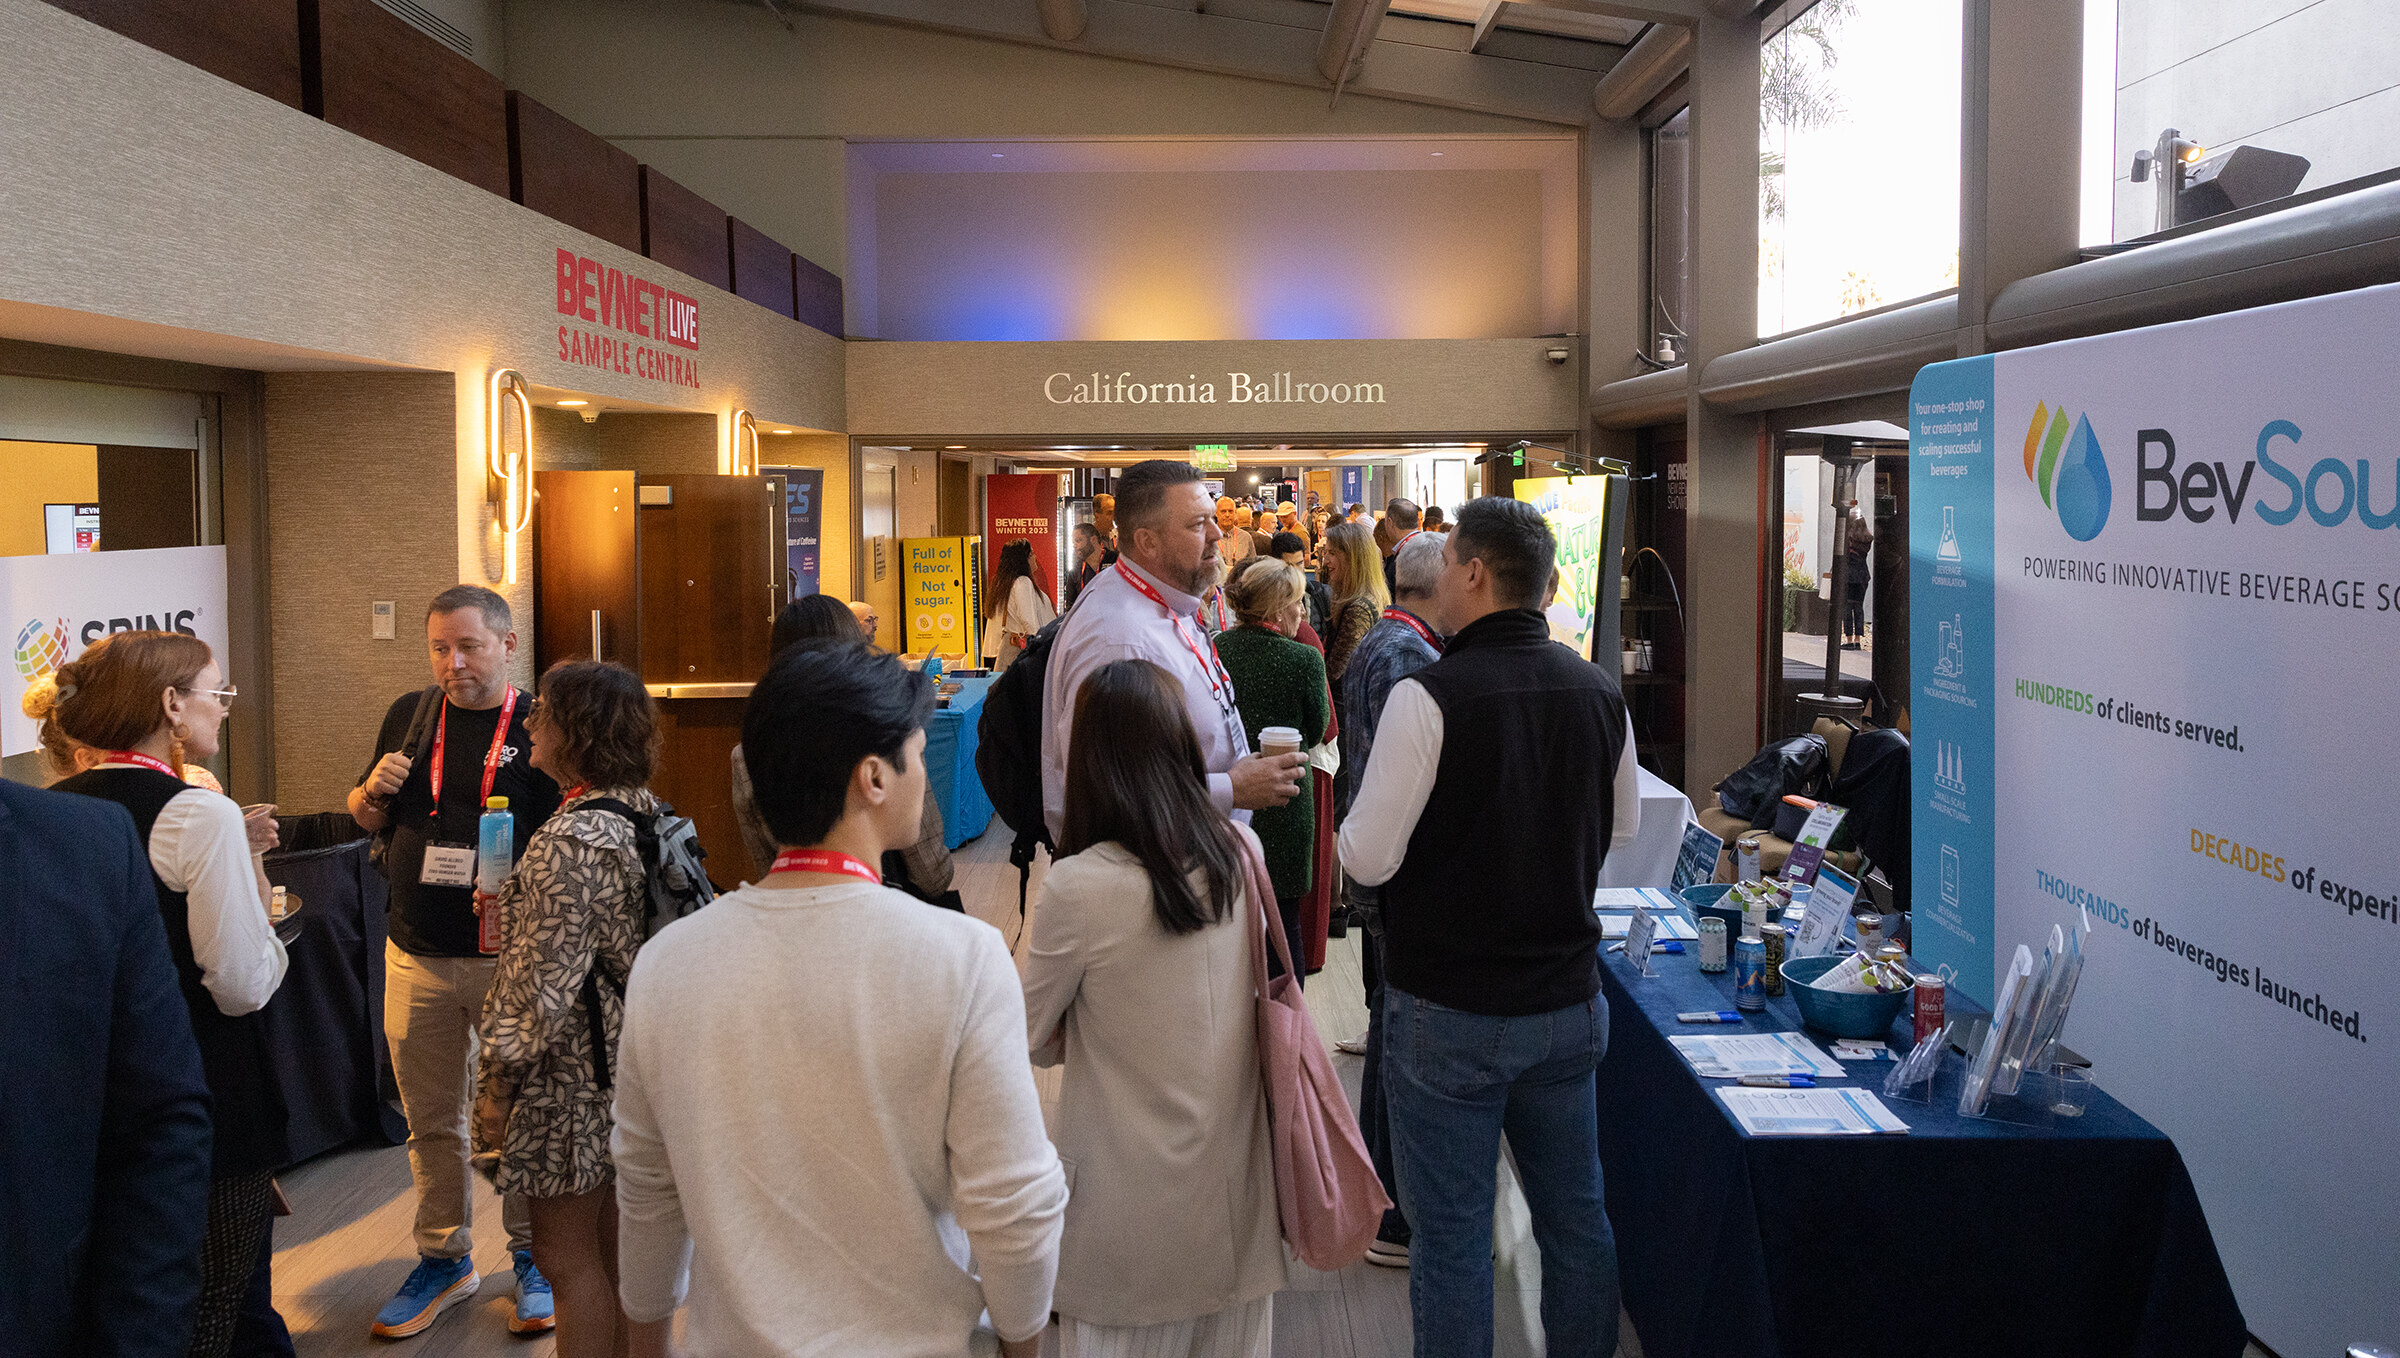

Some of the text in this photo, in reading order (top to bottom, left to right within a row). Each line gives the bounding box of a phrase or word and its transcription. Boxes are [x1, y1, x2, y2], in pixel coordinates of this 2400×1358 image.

[669, 298, 697, 343] LIVE
[558, 325, 700, 389] SAMPLE CENTRAL
[1044, 372, 1387, 404] California Ballroom
[1914, 396, 1985, 415] Your one-stop shop
[1920, 417, 1978, 437] for creating and
[1918, 439, 1982, 459] scaling successful
[1930, 463, 1968, 479] beverages
[2137, 419, 2400, 531] BevSou
[912, 546, 952, 559] Full of
[912, 562, 953, 574] flavor.
[1936, 565, 1962, 576] BEVERAGE
[921, 581, 946, 592] Not
[1931, 576, 1967, 588] FORMULATION
[2024, 556, 2107, 584] POWERING
[2113, 563, 2231, 596] INNOVATIVE
[2240, 573, 2365, 609] BEVERAGE
[914, 596, 953, 608] sugar.
[2015, 678, 2244, 753] HUNDREDS of clients served.
[2190, 828, 2398, 924] DECADES of experi
[2036, 868, 2367, 1044] THOUSANDS of beverages launched.
